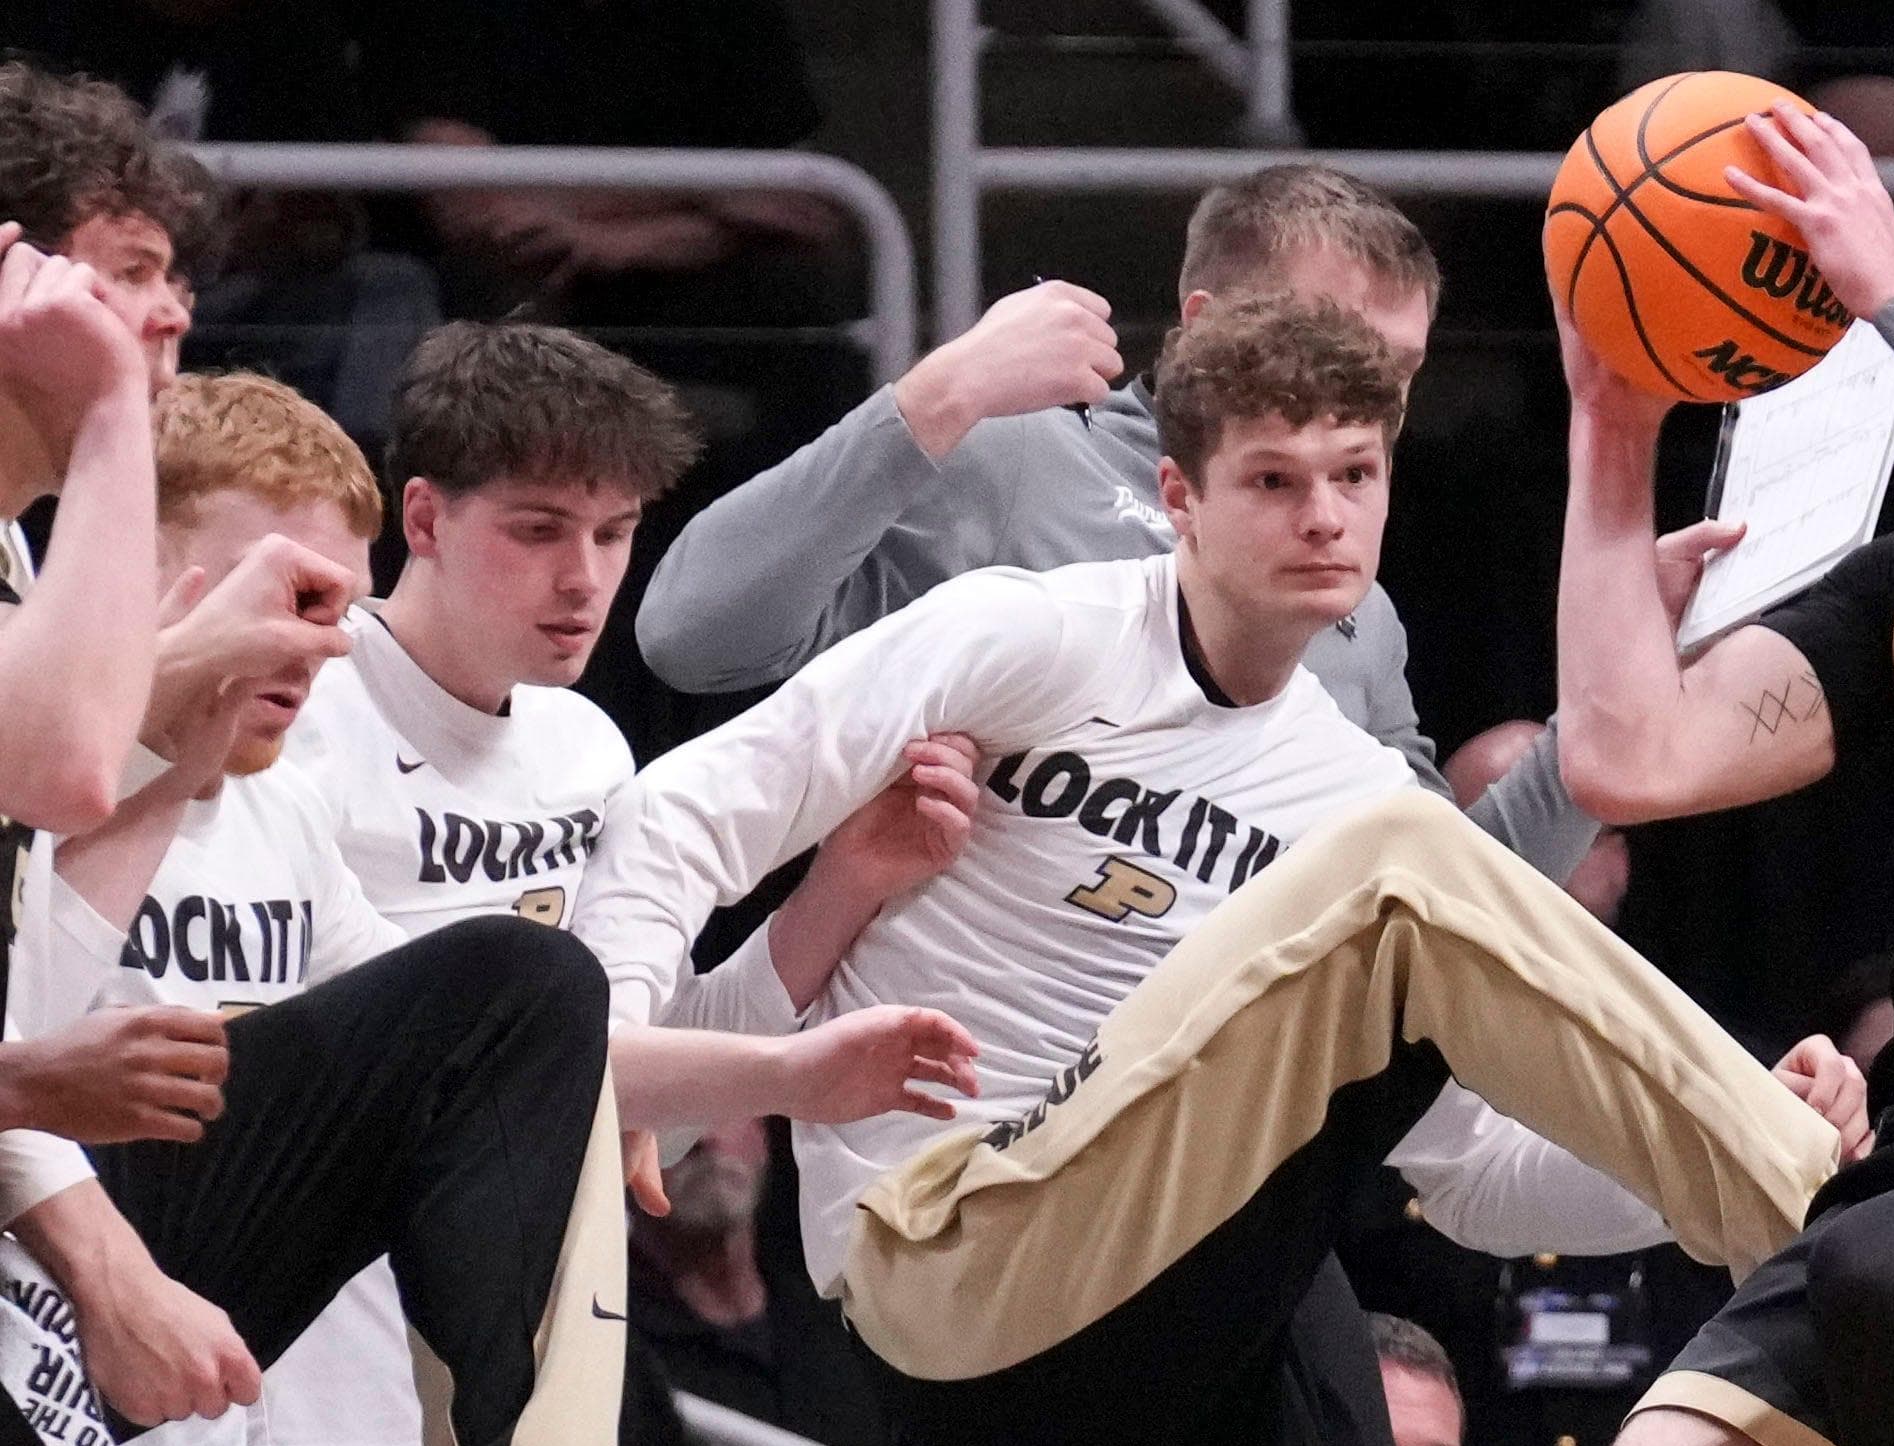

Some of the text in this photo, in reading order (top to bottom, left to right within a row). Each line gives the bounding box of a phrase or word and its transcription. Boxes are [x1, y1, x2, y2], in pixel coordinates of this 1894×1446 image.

[986, 747, 1184, 857] LOCK
[1173, 796, 1238, 884] IT
[1063, 854, 1177, 923] P
